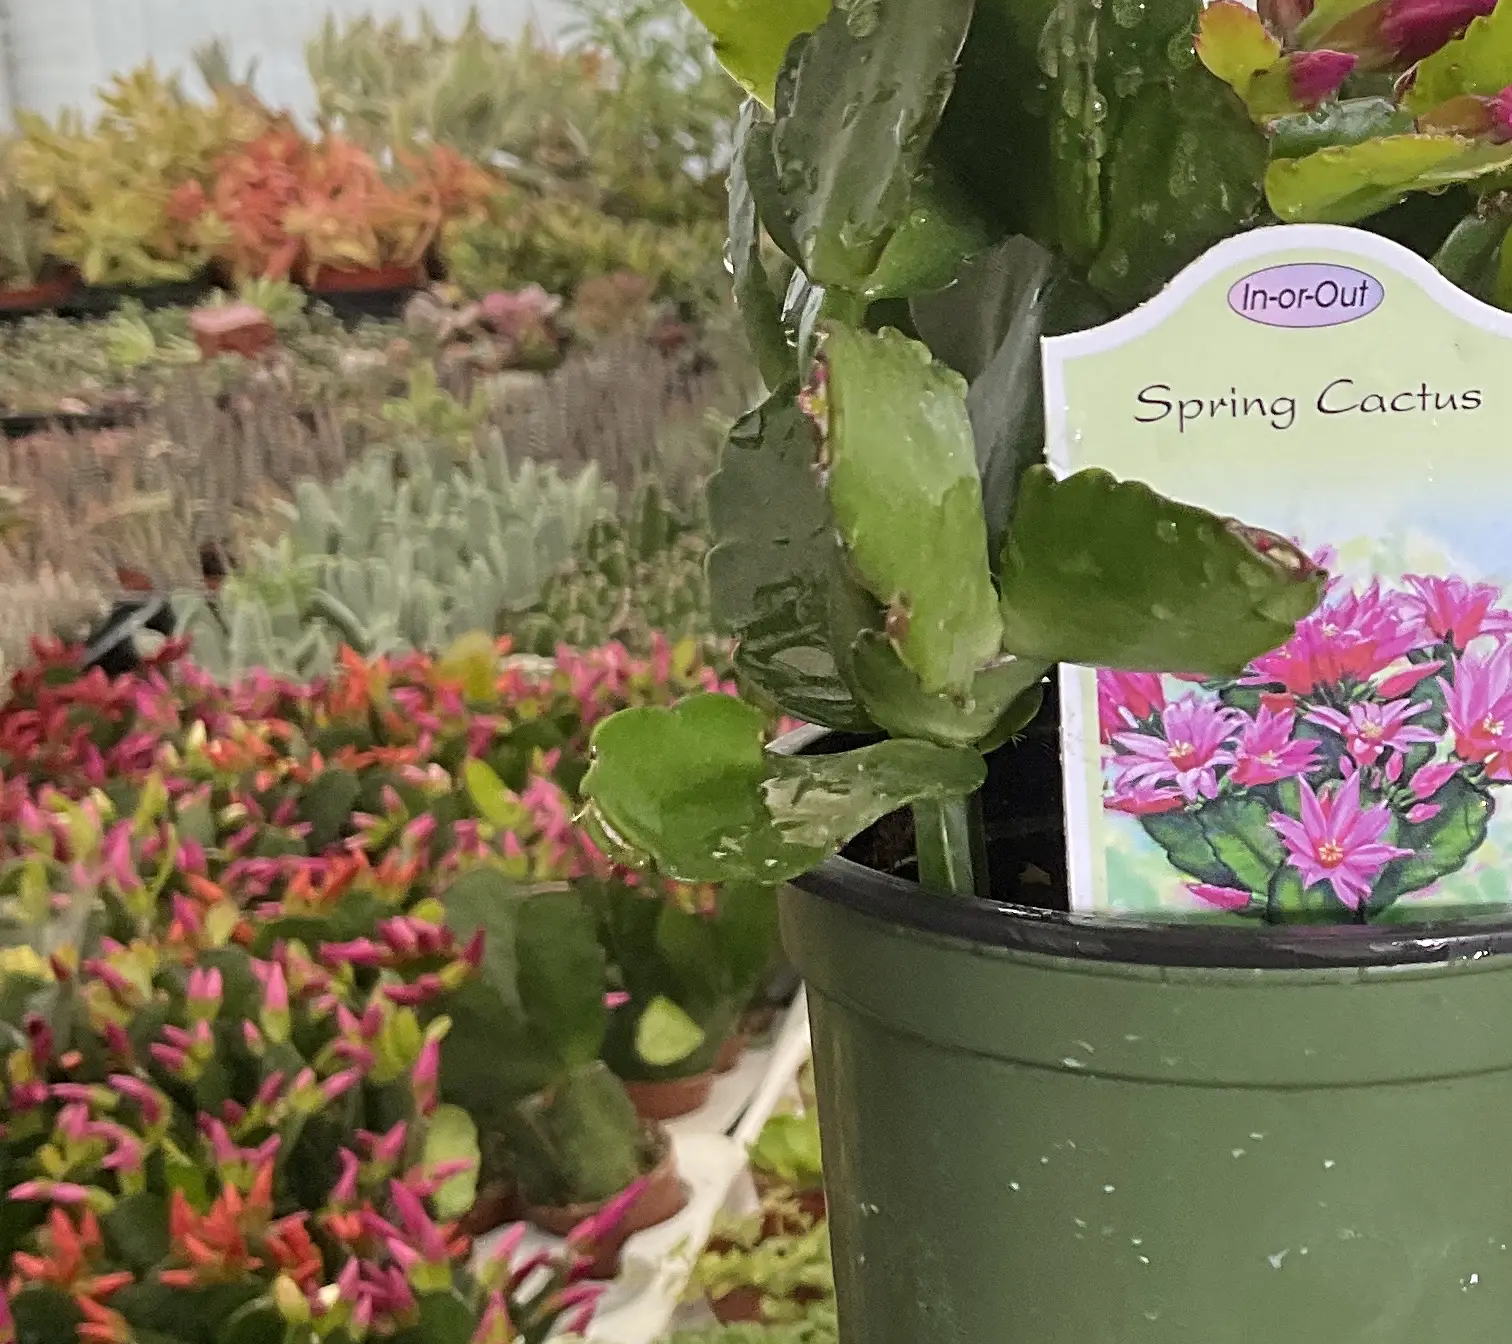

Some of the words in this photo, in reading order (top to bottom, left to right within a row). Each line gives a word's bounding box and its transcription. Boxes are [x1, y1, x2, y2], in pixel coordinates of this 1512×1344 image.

[1241, 279, 1370, 311] In-or-Out
[1134, 383, 1297, 434] Spring
[1316, 378, 1483, 415] Cactus
